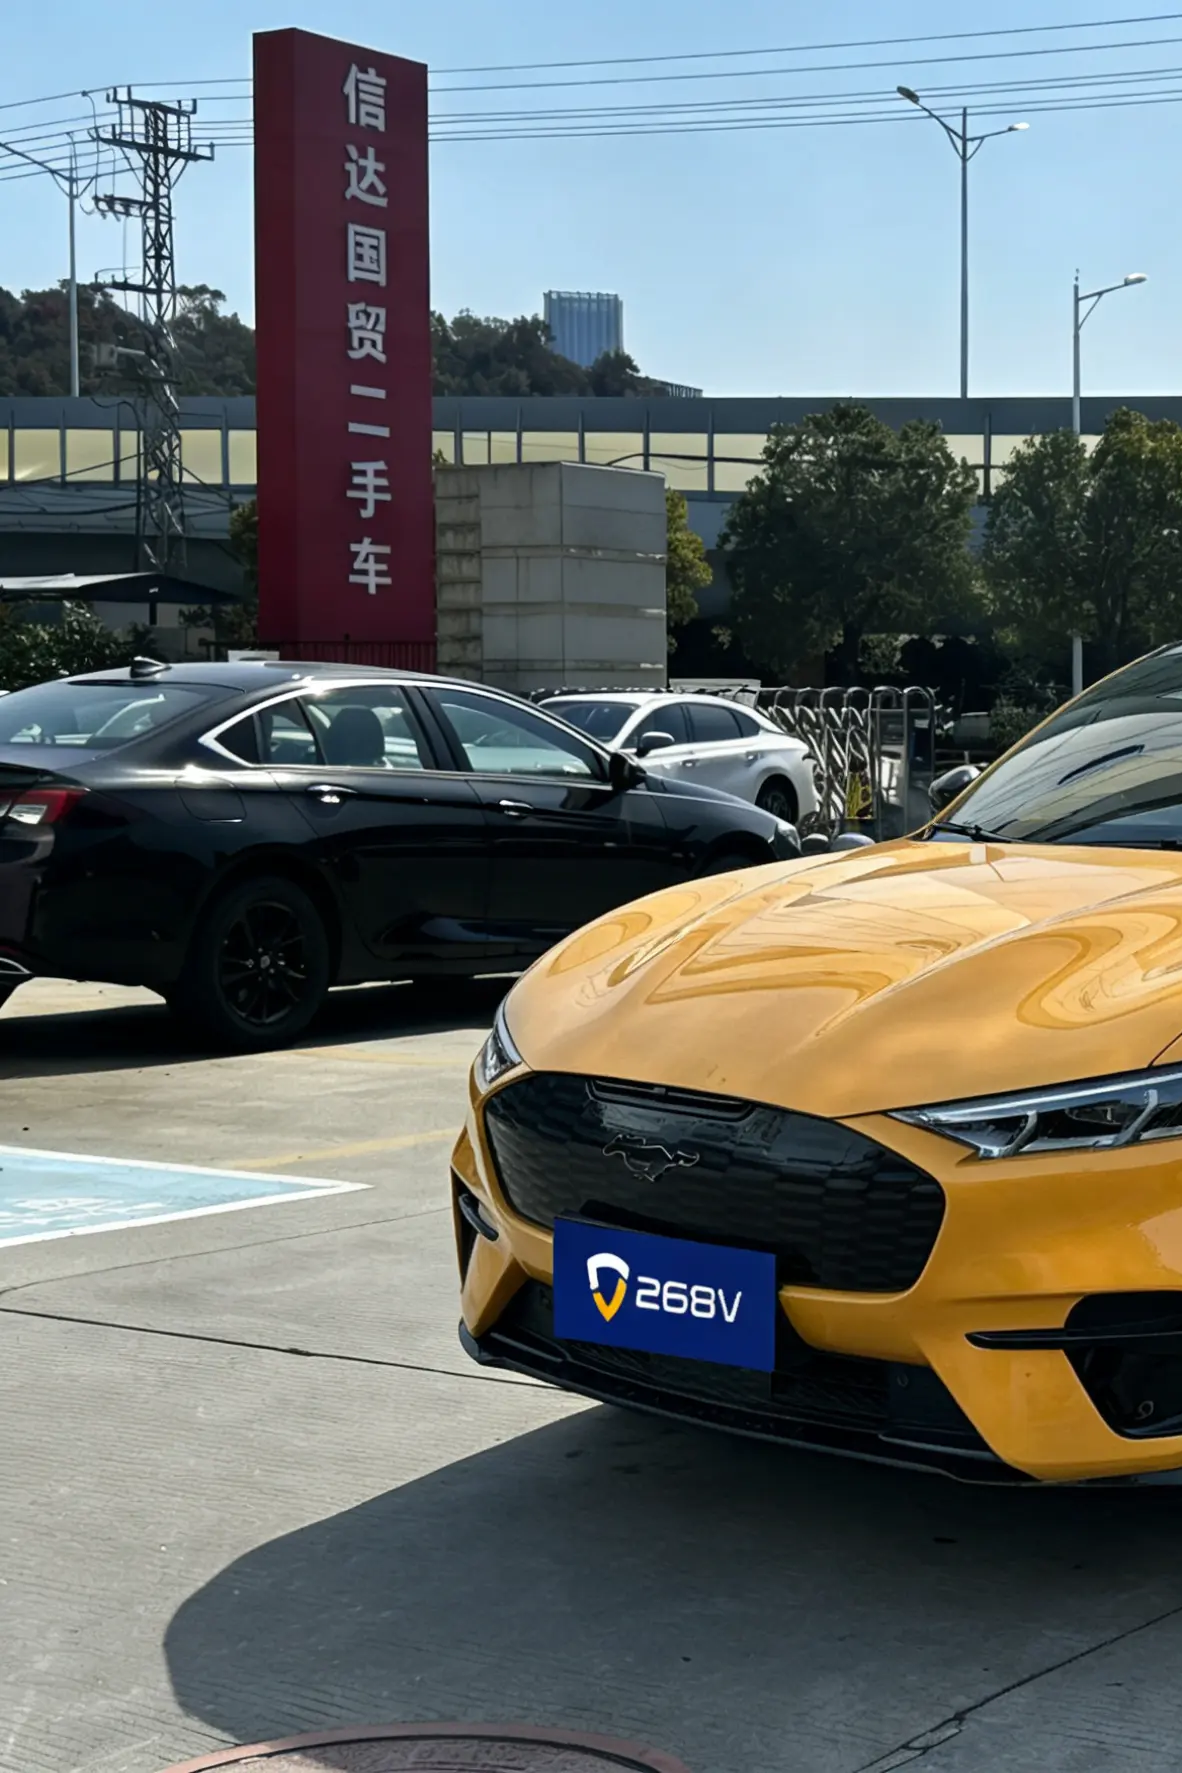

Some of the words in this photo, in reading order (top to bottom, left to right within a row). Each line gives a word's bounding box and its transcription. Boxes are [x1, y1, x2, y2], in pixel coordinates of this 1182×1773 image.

[343, 63, 392, 594] 信达国贸二手车
